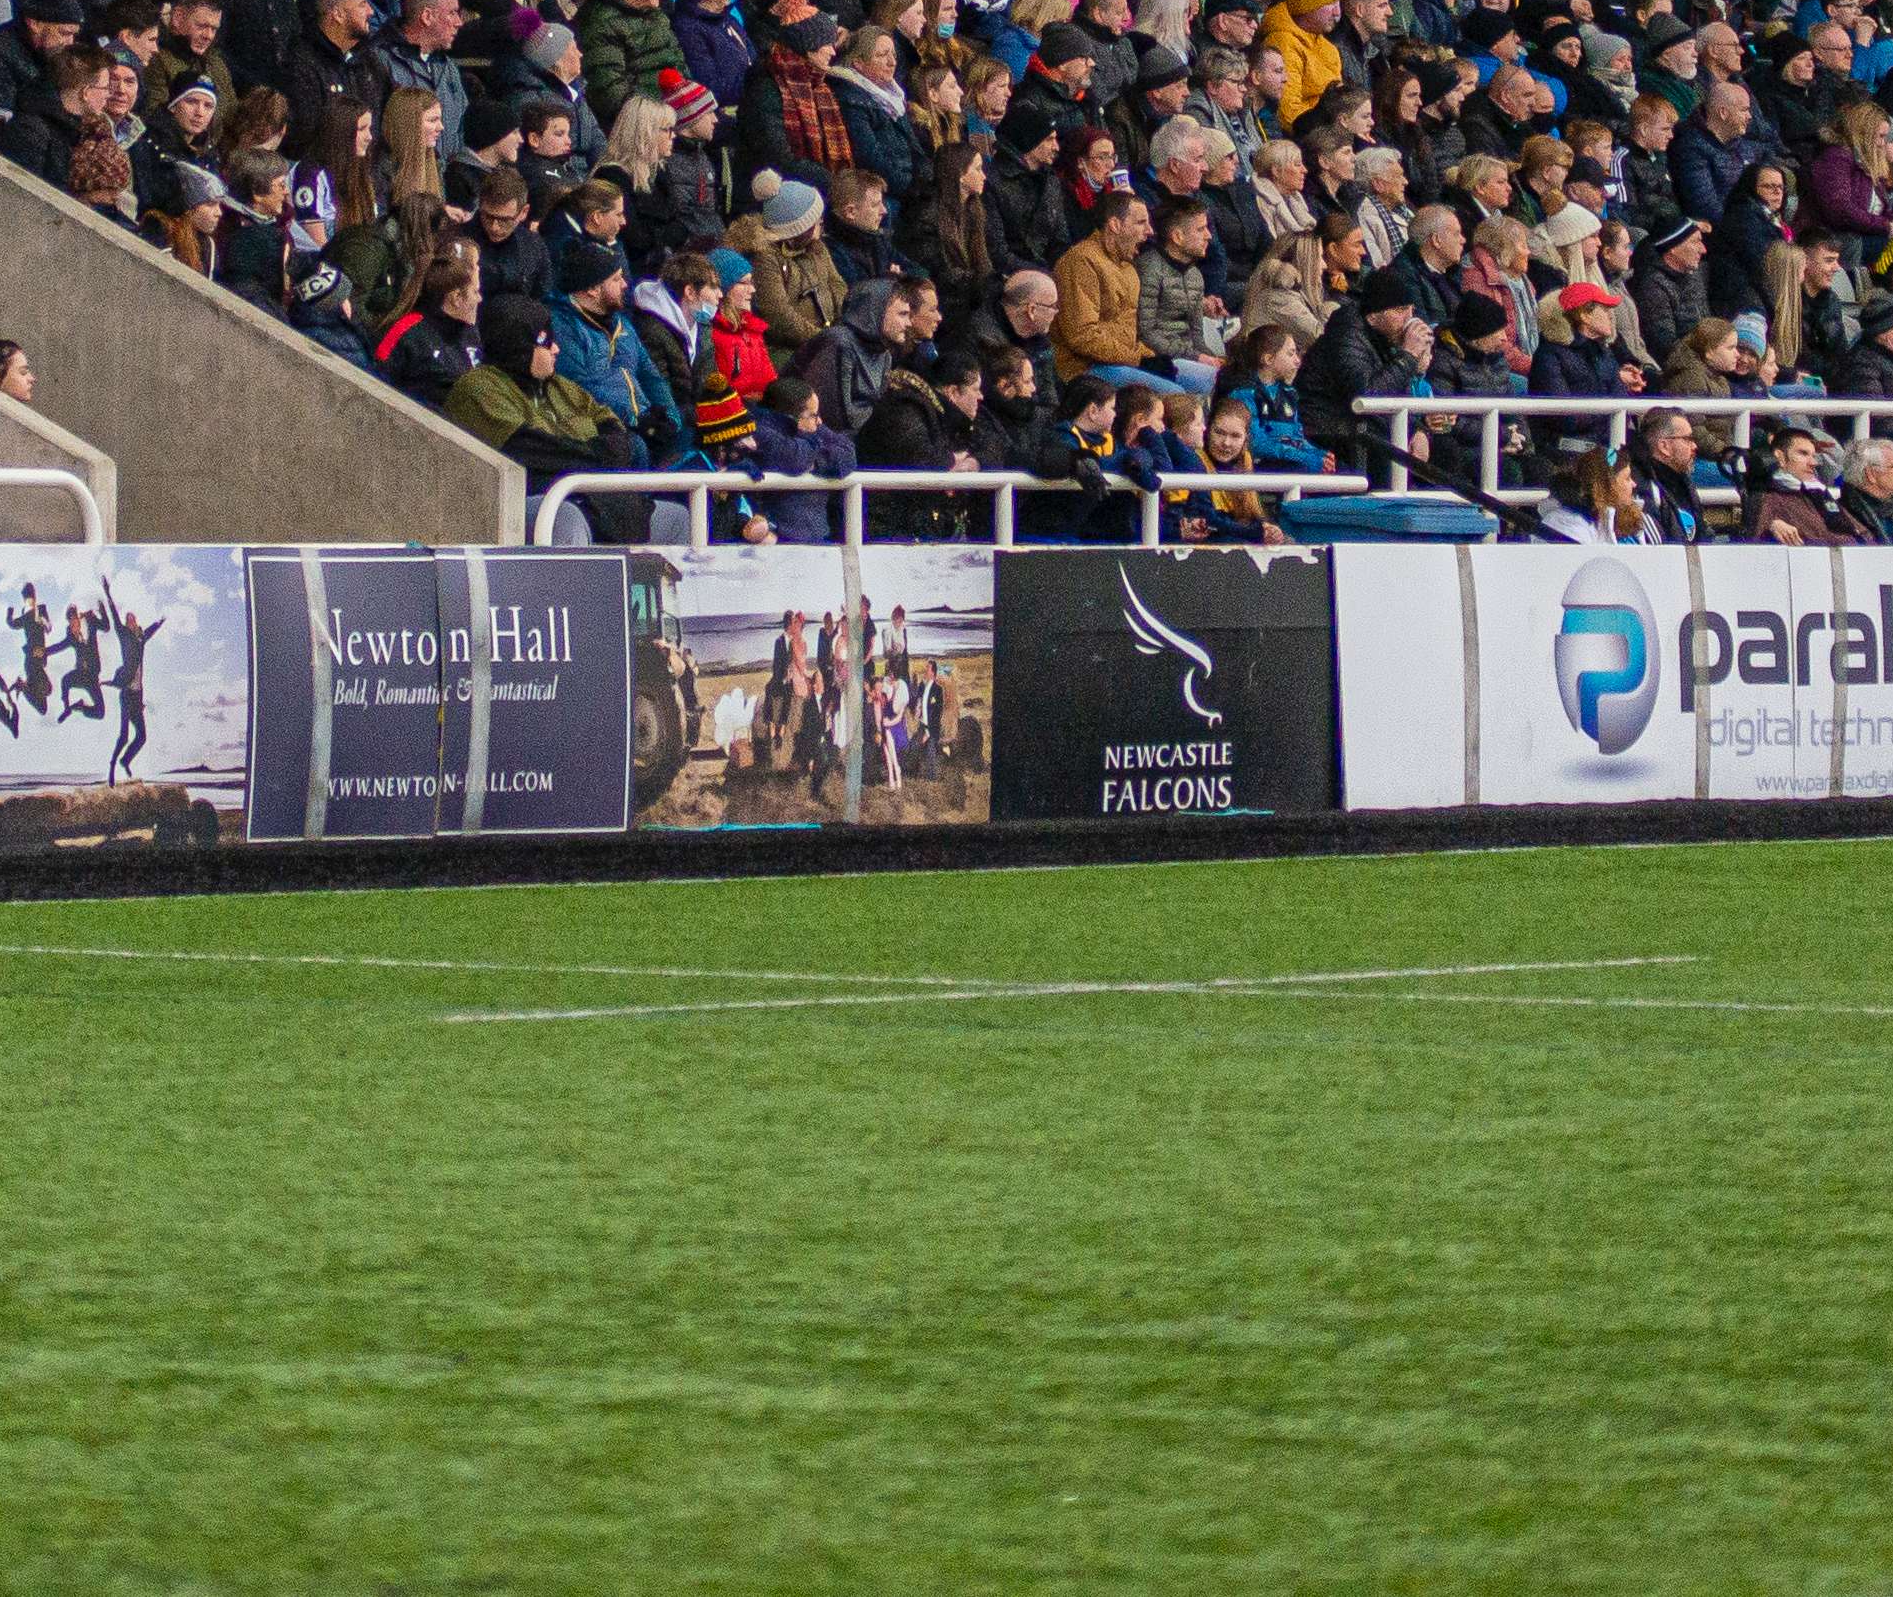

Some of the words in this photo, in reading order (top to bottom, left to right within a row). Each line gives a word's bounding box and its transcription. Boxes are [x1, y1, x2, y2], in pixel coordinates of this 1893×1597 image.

[311, 608, 472, 667] Newton
[489, 606, 572, 663] Hall
[334, 677, 369, 710] Bold,
[375, 679, 451, 706] Romantic
[489, 674, 559, 702] antastical
[1707, 708, 1802, 758] digital
[1104, 741, 1233, 770] NEWCASTLE
[1102, 775, 1232, 813] FALCONS
